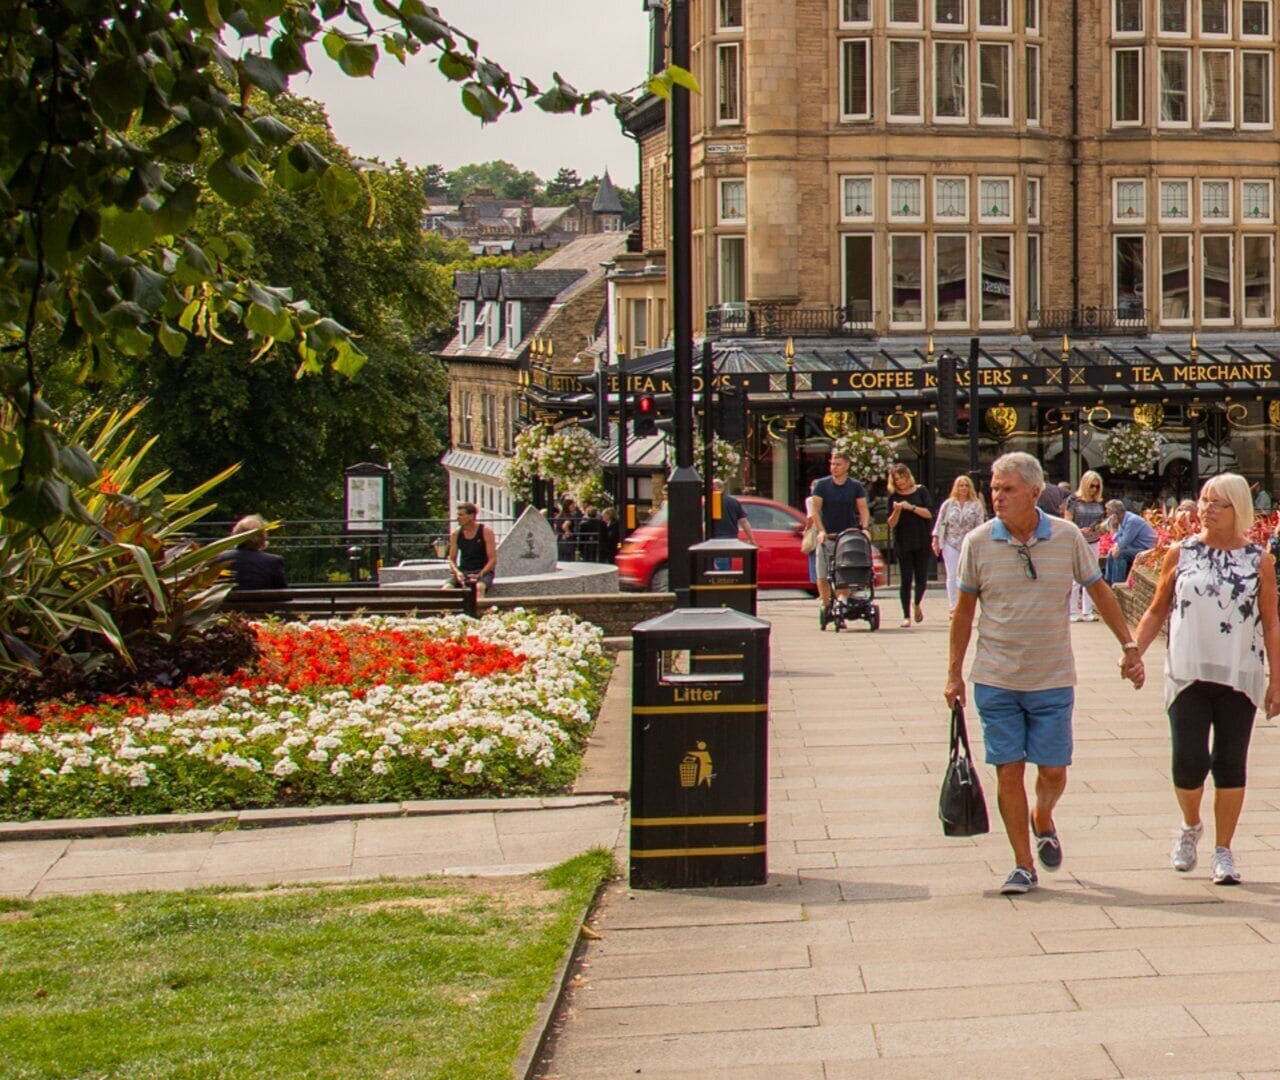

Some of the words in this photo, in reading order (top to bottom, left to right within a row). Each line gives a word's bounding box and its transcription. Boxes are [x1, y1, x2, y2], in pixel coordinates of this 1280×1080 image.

[849, 372, 915, 389] COFFEE
[1132, 367, 1164, 383] TEA
[1174, 364, 1272, 382] MERCHANTS
[674, 687, 722, 702] Litter
